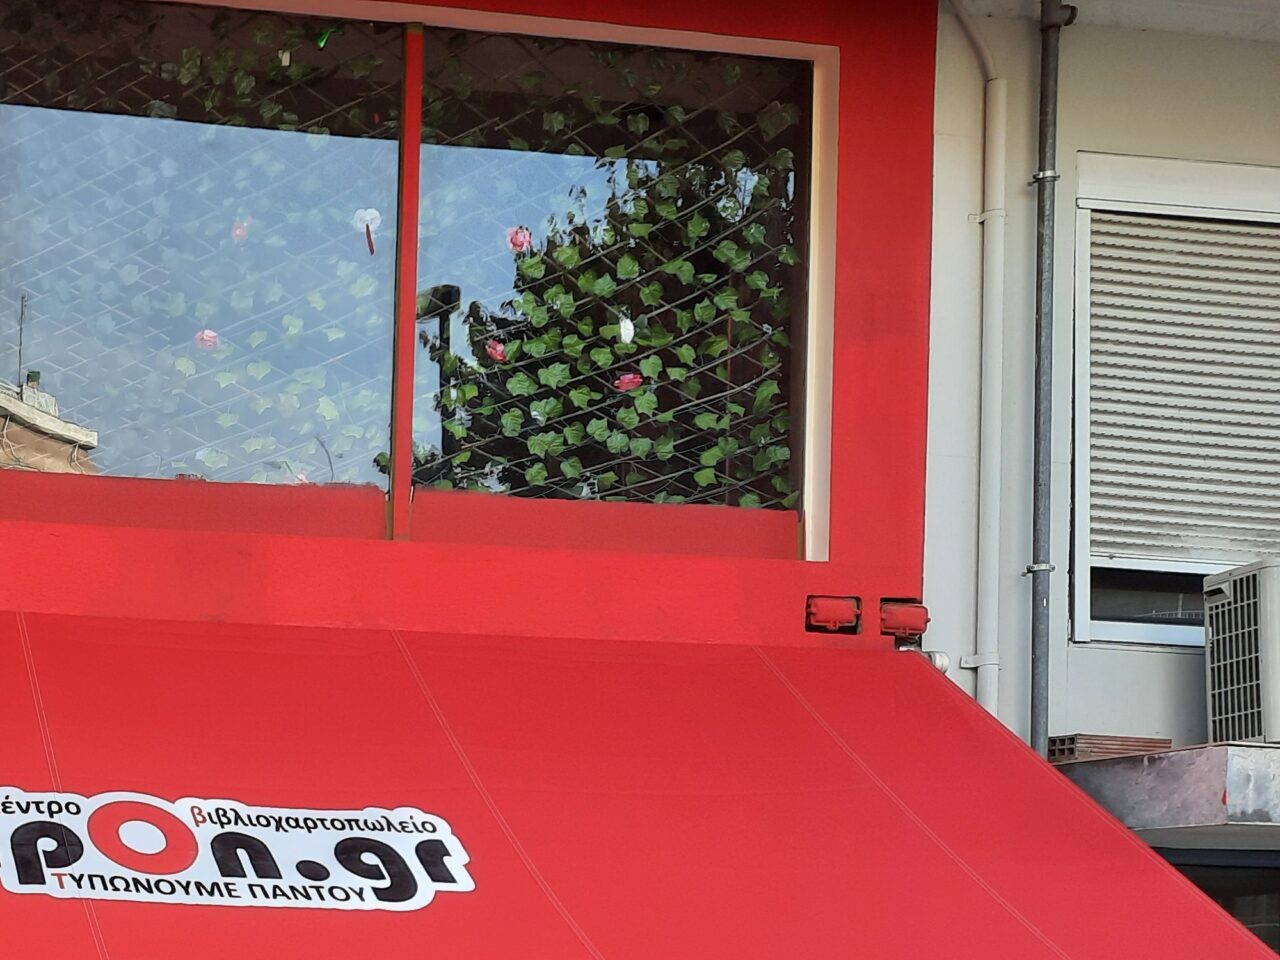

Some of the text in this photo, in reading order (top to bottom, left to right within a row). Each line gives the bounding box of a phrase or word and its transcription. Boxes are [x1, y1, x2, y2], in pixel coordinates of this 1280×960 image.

[190, 805, 438, 834] βιβλιοχαρτοπωλείο
[51, 873, 366, 902] ΤΥΠΩΝΟΥΜΕ ΠΑΝΤΟΥ
